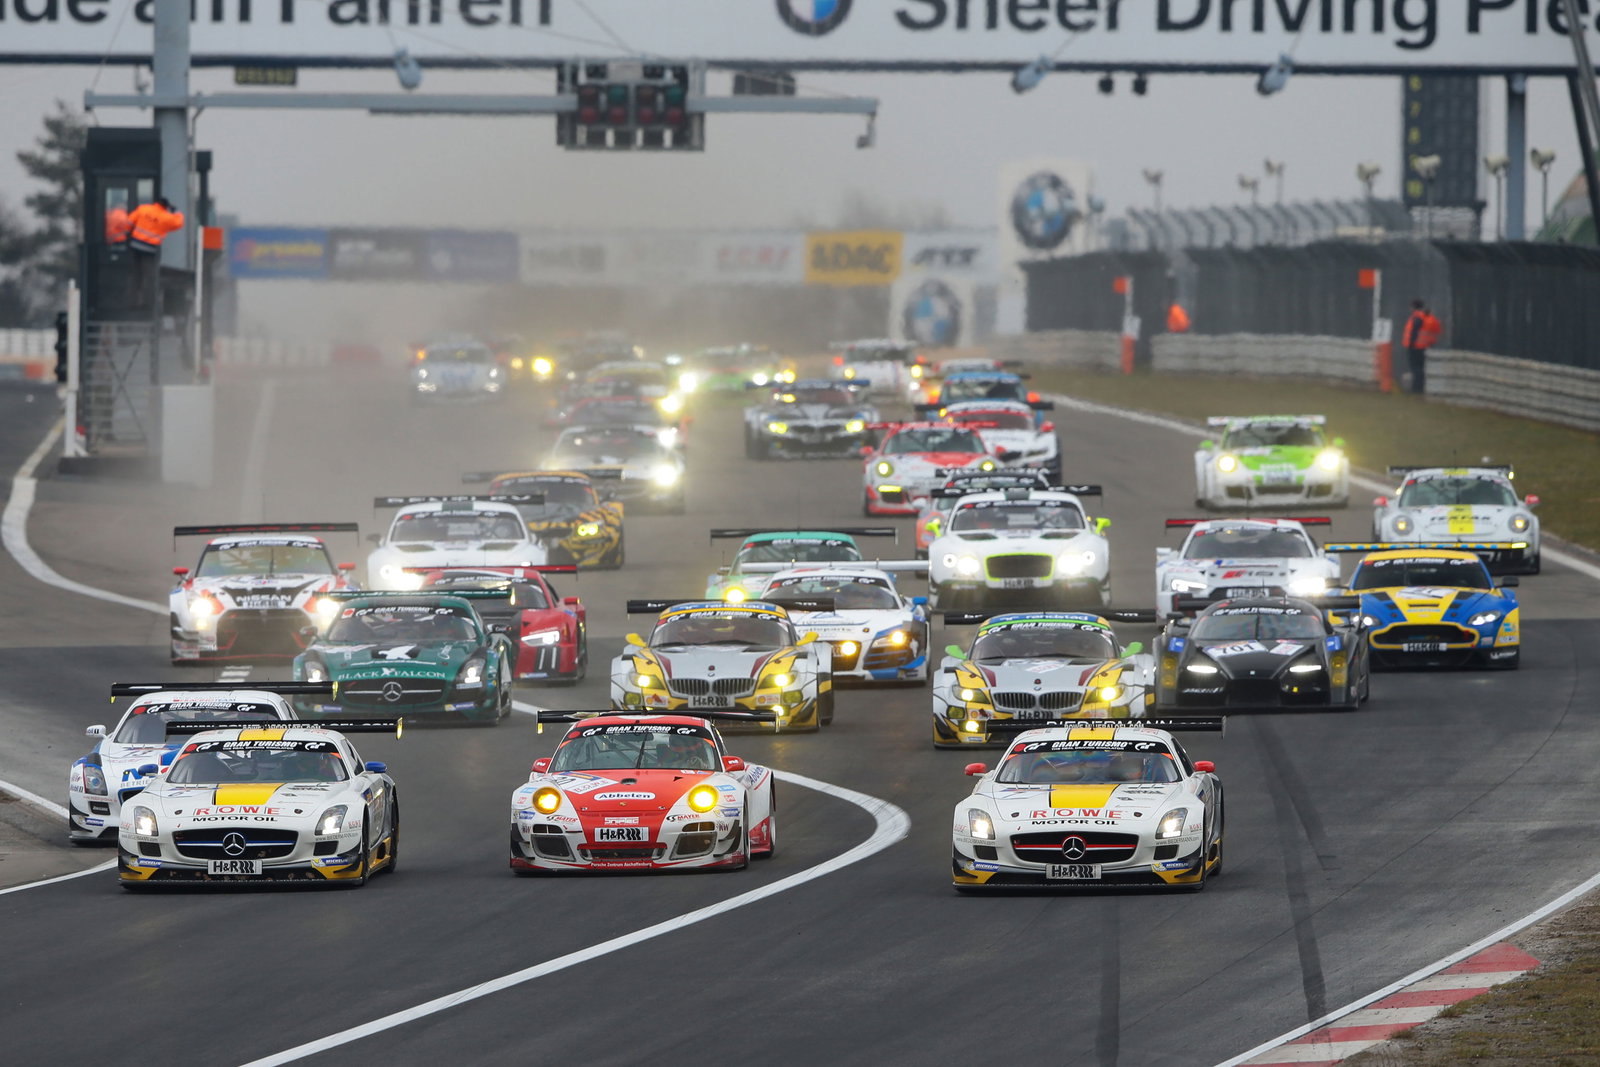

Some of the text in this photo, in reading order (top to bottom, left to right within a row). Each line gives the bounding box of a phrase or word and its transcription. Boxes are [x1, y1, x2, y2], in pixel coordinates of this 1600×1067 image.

[894, 0, 1600, 51] Sheer Driving Ple
[811, 242, 894, 273] ADAC
[236, 594, 292, 602] NISSAN
[1221, 643, 1256, 654] 701
[337, 669, 446, 681] BLACK FALCON
[253, 740, 302, 748] TURISMO
[598, 791, 651, 799] Abbelen
[195, 806, 280, 815] ROWE
[1032, 808, 1122, 819] ROWE
